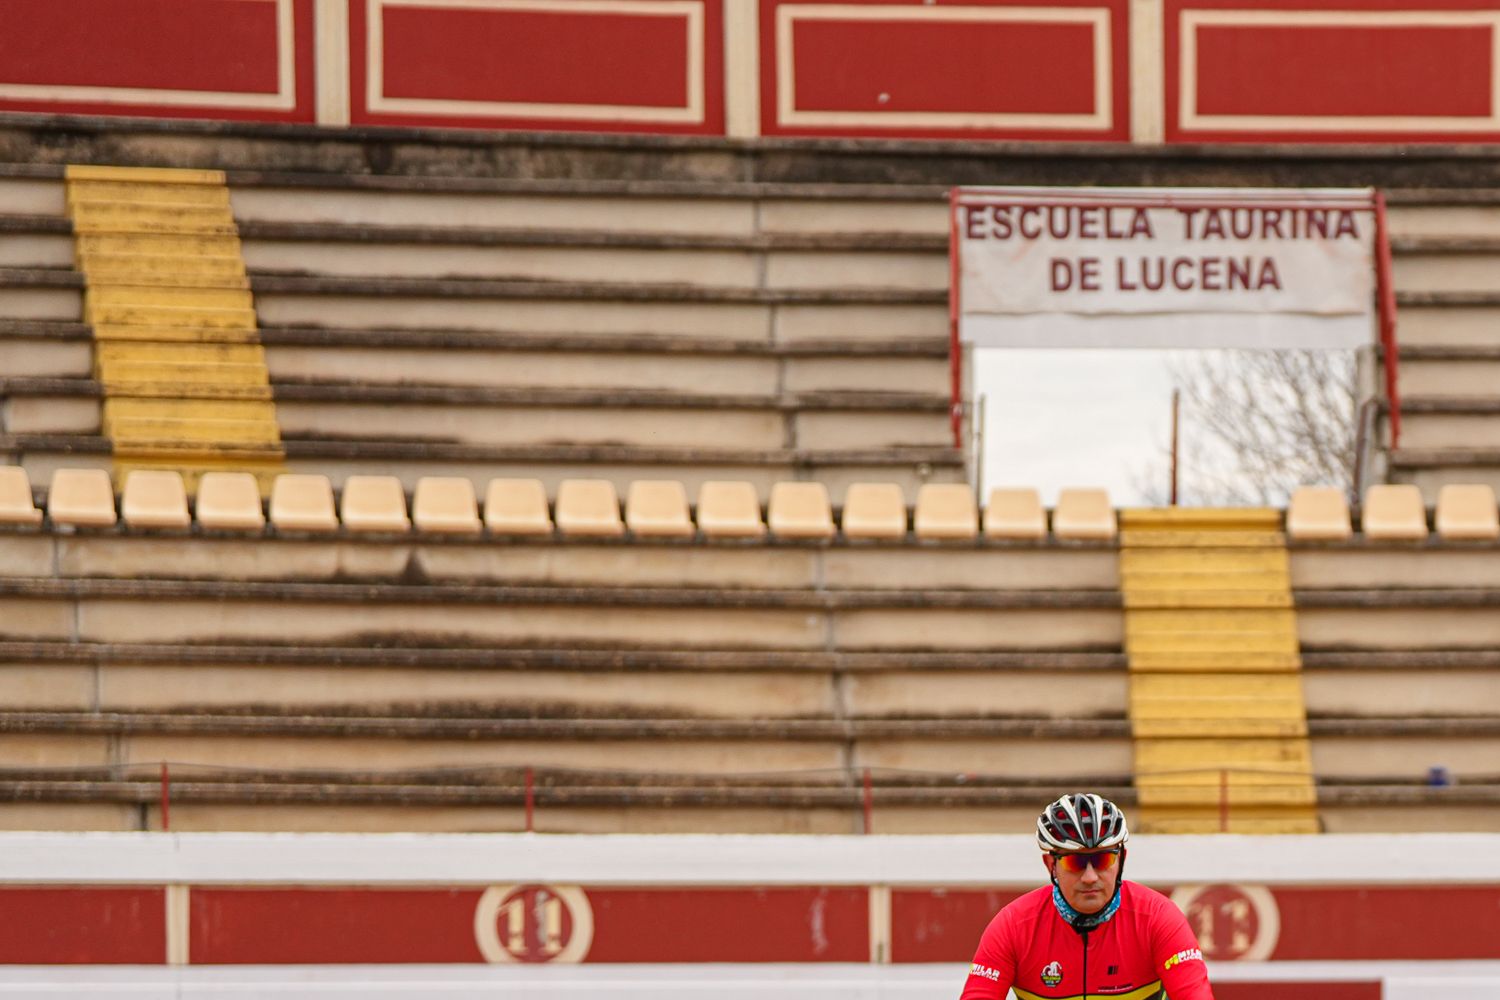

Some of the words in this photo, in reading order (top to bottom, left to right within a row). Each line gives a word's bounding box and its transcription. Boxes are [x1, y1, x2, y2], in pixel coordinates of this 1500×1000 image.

[964, 206, 1155, 241] ESCUELA
[1178, 207, 1360, 241] TAURINA
[1049, 256, 1101, 293] DE
[1116, 256, 1282, 292] LUCENA
[497, 896, 563, 953] 11
